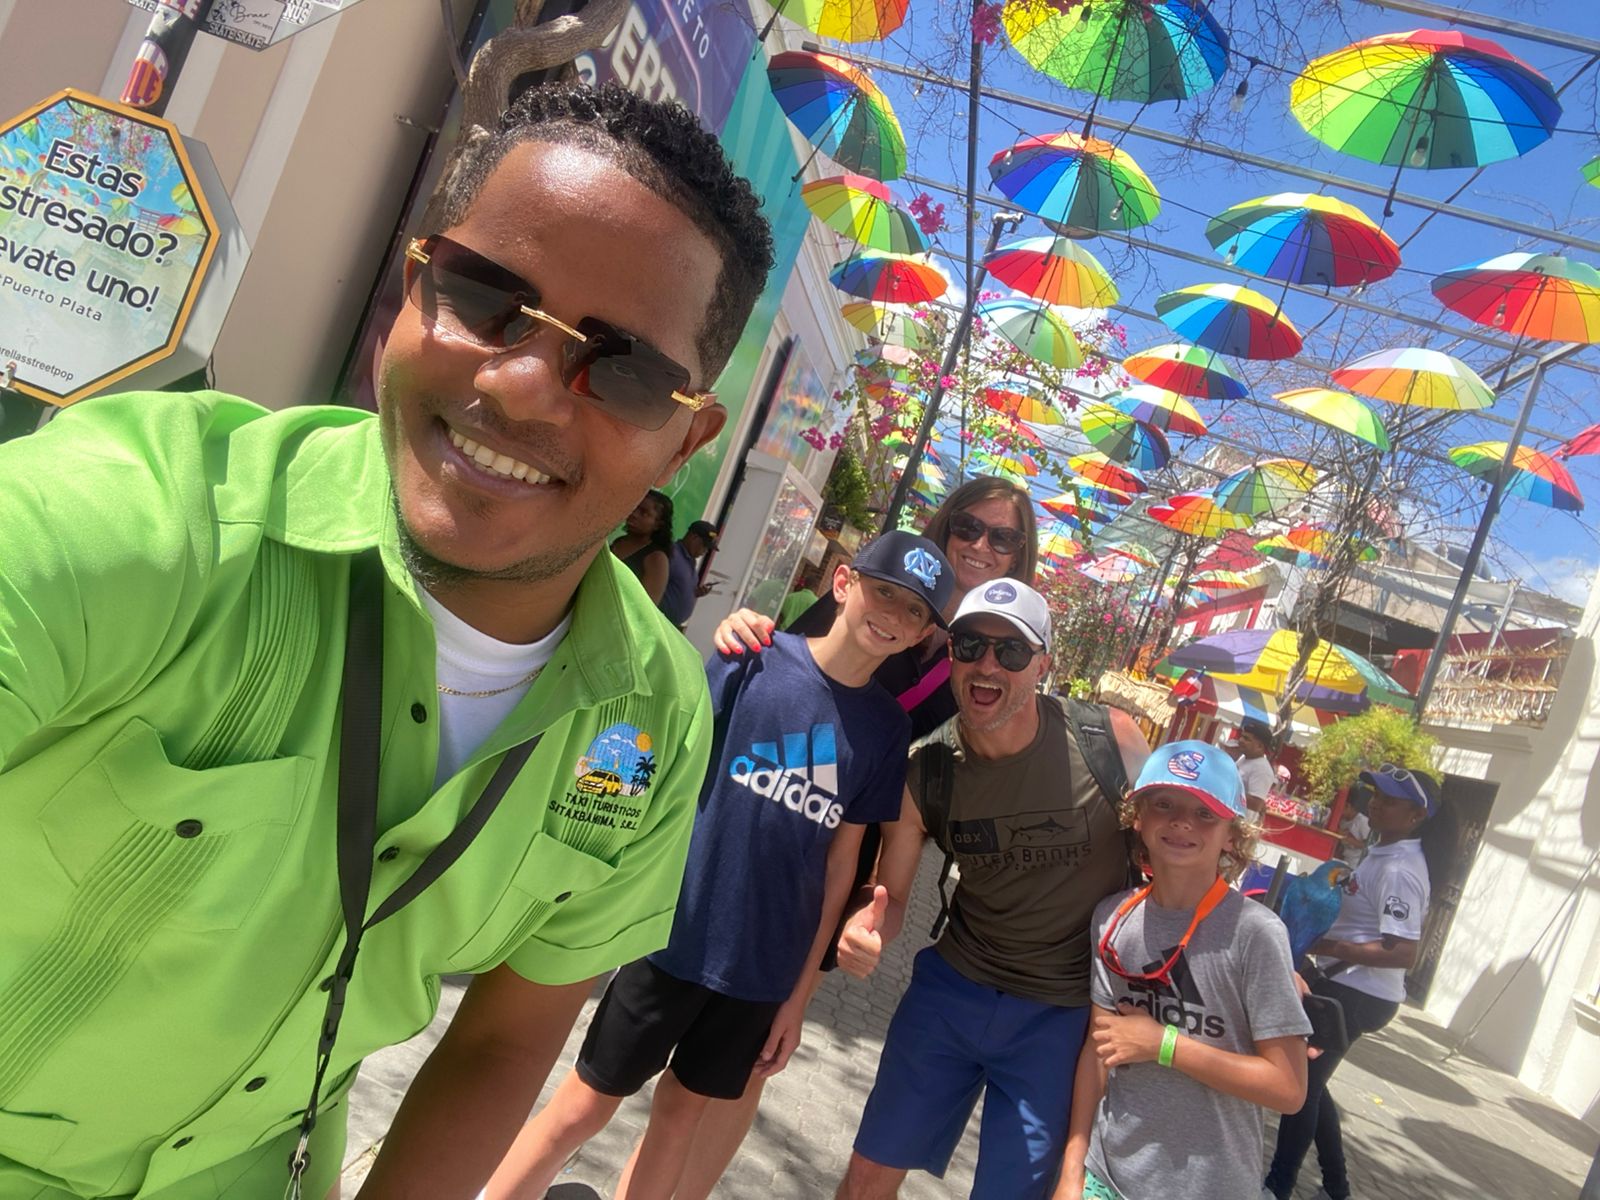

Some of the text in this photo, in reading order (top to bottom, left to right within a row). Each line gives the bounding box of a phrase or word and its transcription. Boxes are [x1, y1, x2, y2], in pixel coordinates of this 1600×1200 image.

[45, 139, 143, 198] Estas
[0, 175, 179, 263] stresado?
[60, 297, 102, 321] Plata
[86, 270, 160, 312] uno!
[565, 792, 641, 818] TAXI TURISTICOS
[730, 756, 843, 829] adidas
